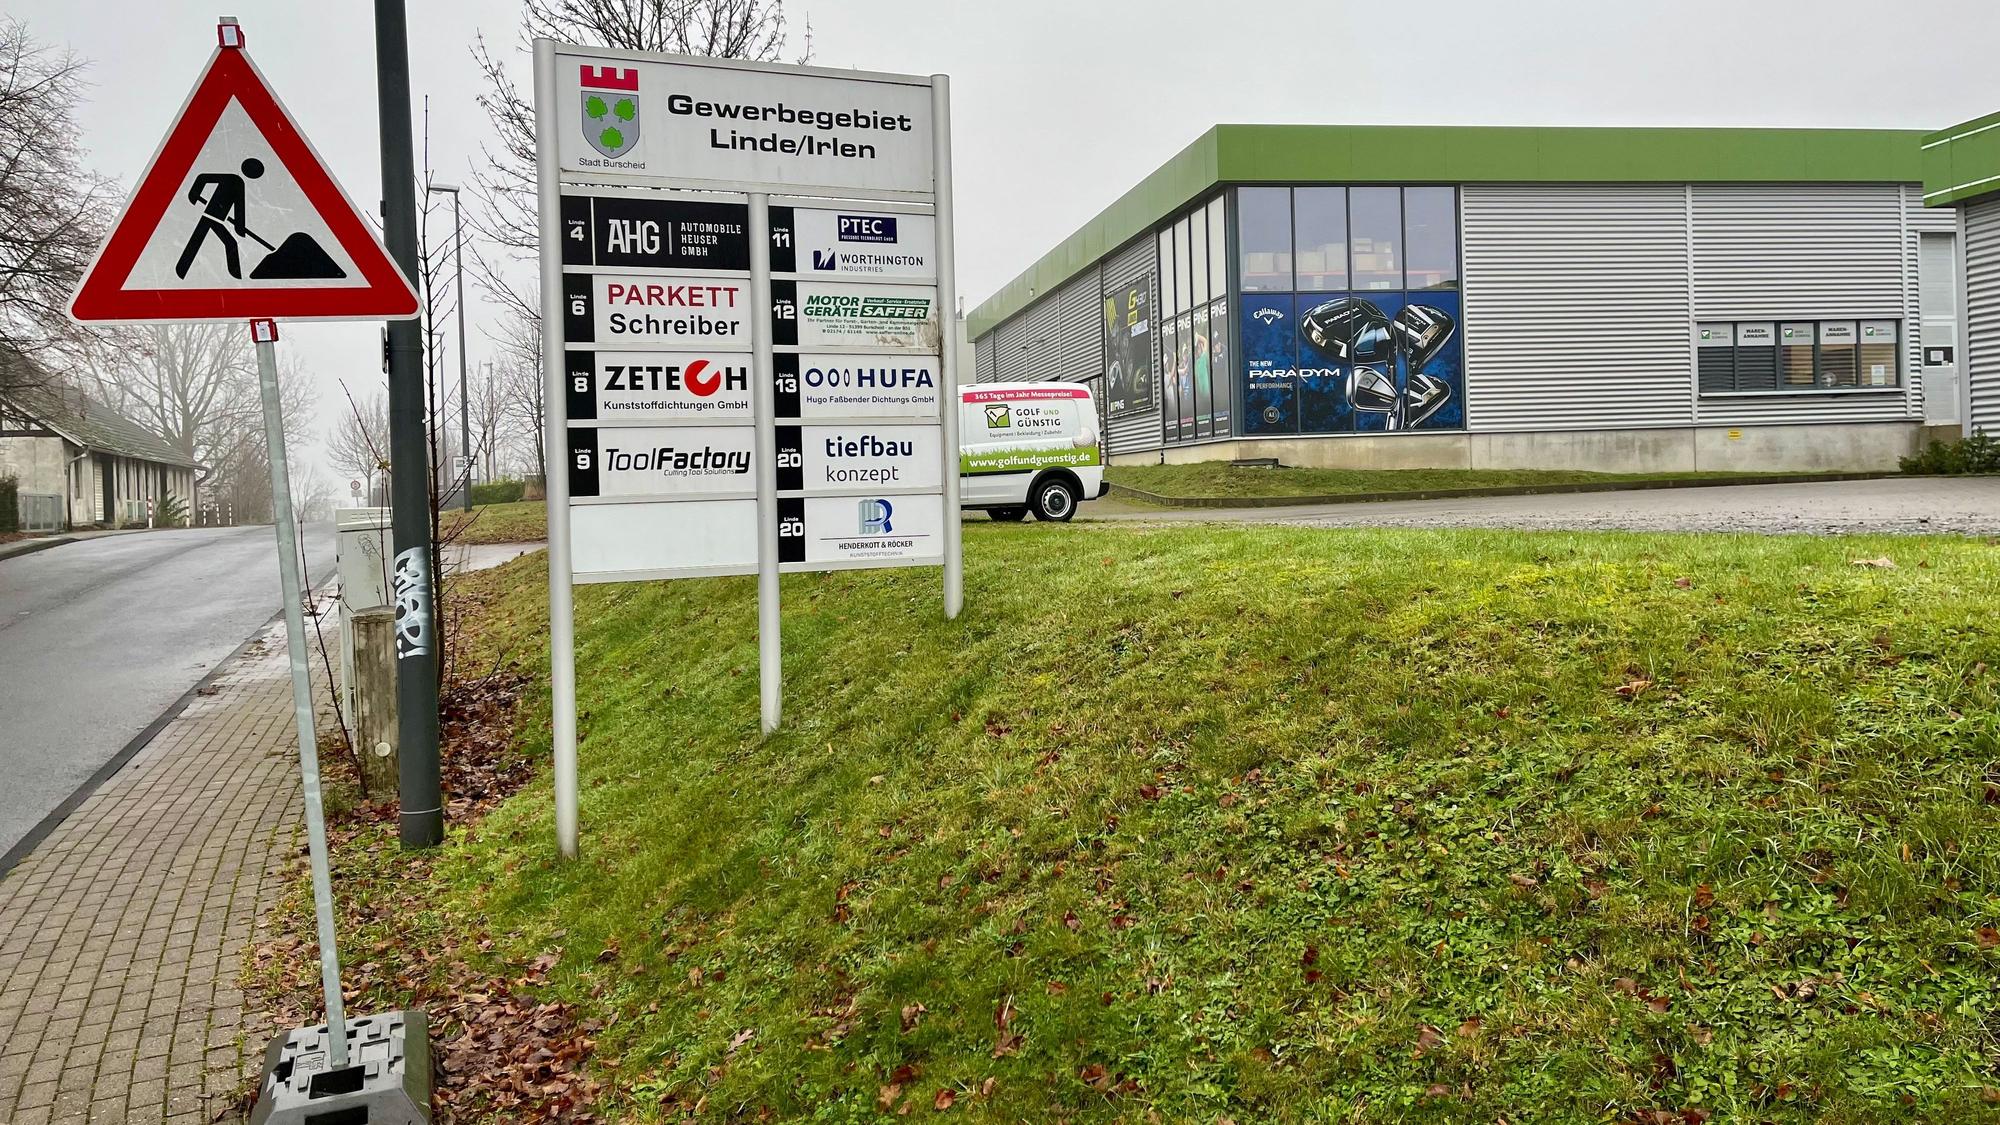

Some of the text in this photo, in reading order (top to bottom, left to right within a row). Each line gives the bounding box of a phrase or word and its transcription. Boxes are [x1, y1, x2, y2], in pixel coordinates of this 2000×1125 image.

[667, 94, 912, 132] Gewerbegebiet
[710, 128, 876, 159] Linde/Irlen
[578, 157, 646, 170] Stadt Burscheid
[680, 222, 742, 234] AUTOMOBILE
[840, 218, 882, 234] PTEC
[570, 226, 584, 242] 4
[607, 218, 660, 254] AHG
[681, 234, 718, 245] HEUSER
[772, 233, 790, 248] 11
[682, 246, 708, 256] GMBH
[840, 254, 924, 266] WORTHINGTON
[608, 284, 739, 308] PARKETT
[806, 295, 860, 306] MOTOR
[572, 300, 586, 316] 6
[773, 305, 795, 320] 12
[804, 306, 858, 317] GERÄTE
[862, 306, 926, 318] SAFFER
[1253, 307, 1284, 319] Callaway
[609, 313, 740, 336] Schreiber
[604, 359, 748, 396] ZETECH
[858, 368, 934, 388] HUFA
[1249, 366, 1340, 380] PARADYM
[574, 377, 588, 392] 8
[776, 378, 797, 393] 13
[604, 400, 748, 411] Kunststoffdichtungen GmbH
[806, 396, 828, 405] Hugo
[872, 396, 910, 405] Dichtungs
[1016, 408, 1040, 416] GOLF
[1017, 417, 1061, 427] GÜNSTIG
[826, 436, 912, 457] tiefbau
[576, 455, 590, 470] 9
[606, 446, 750, 474] ToolFactory
[777, 454, 801, 468] 20
[970, 452, 1090, 468] www.golfundguenstig.de
[826, 465, 899, 484] konzept
[780, 522, 804, 537] 20
[838, 541, 880, 550] HENDERKOTT
[888, 540, 913, 548] RÖCKER
